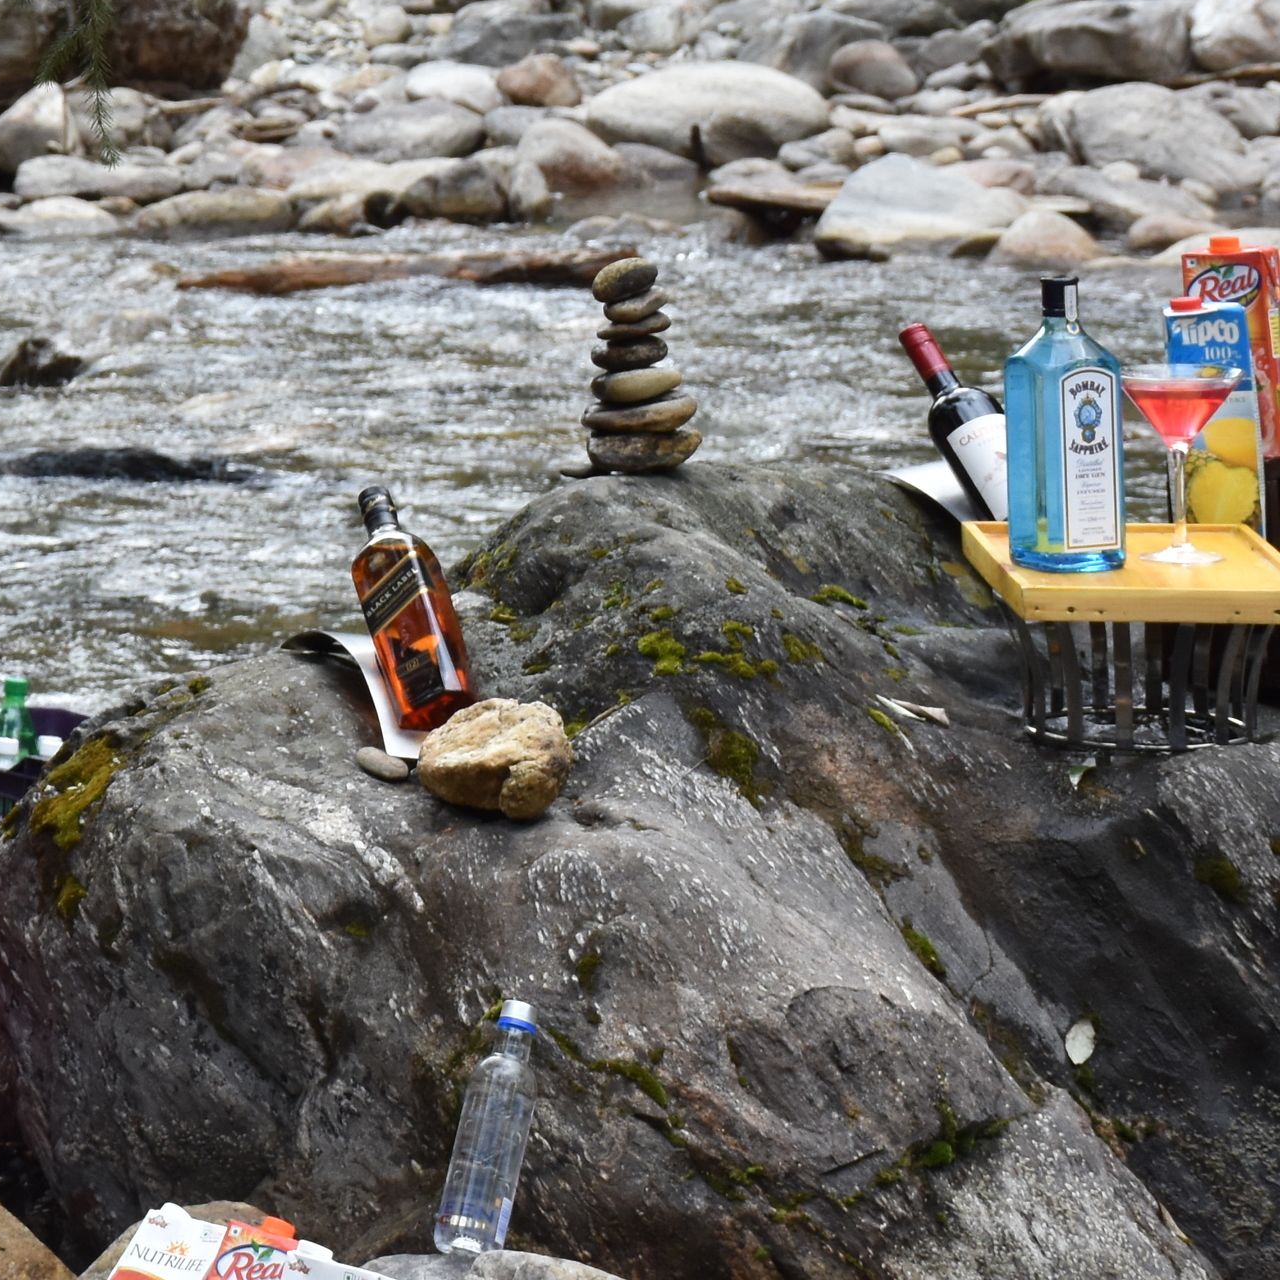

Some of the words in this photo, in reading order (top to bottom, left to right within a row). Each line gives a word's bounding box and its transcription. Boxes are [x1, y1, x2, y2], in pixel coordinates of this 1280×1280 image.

[1199, 267, 1255, 303] Real
[1069, 381, 1106, 400] BOMBAY
[1069, 436, 1110, 455] SAPPHIRE
[365, 591, 392, 618] BLACK
[391, 567, 419, 593] LABEL
[129, 1243, 204, 1272] NUTRILIFE
